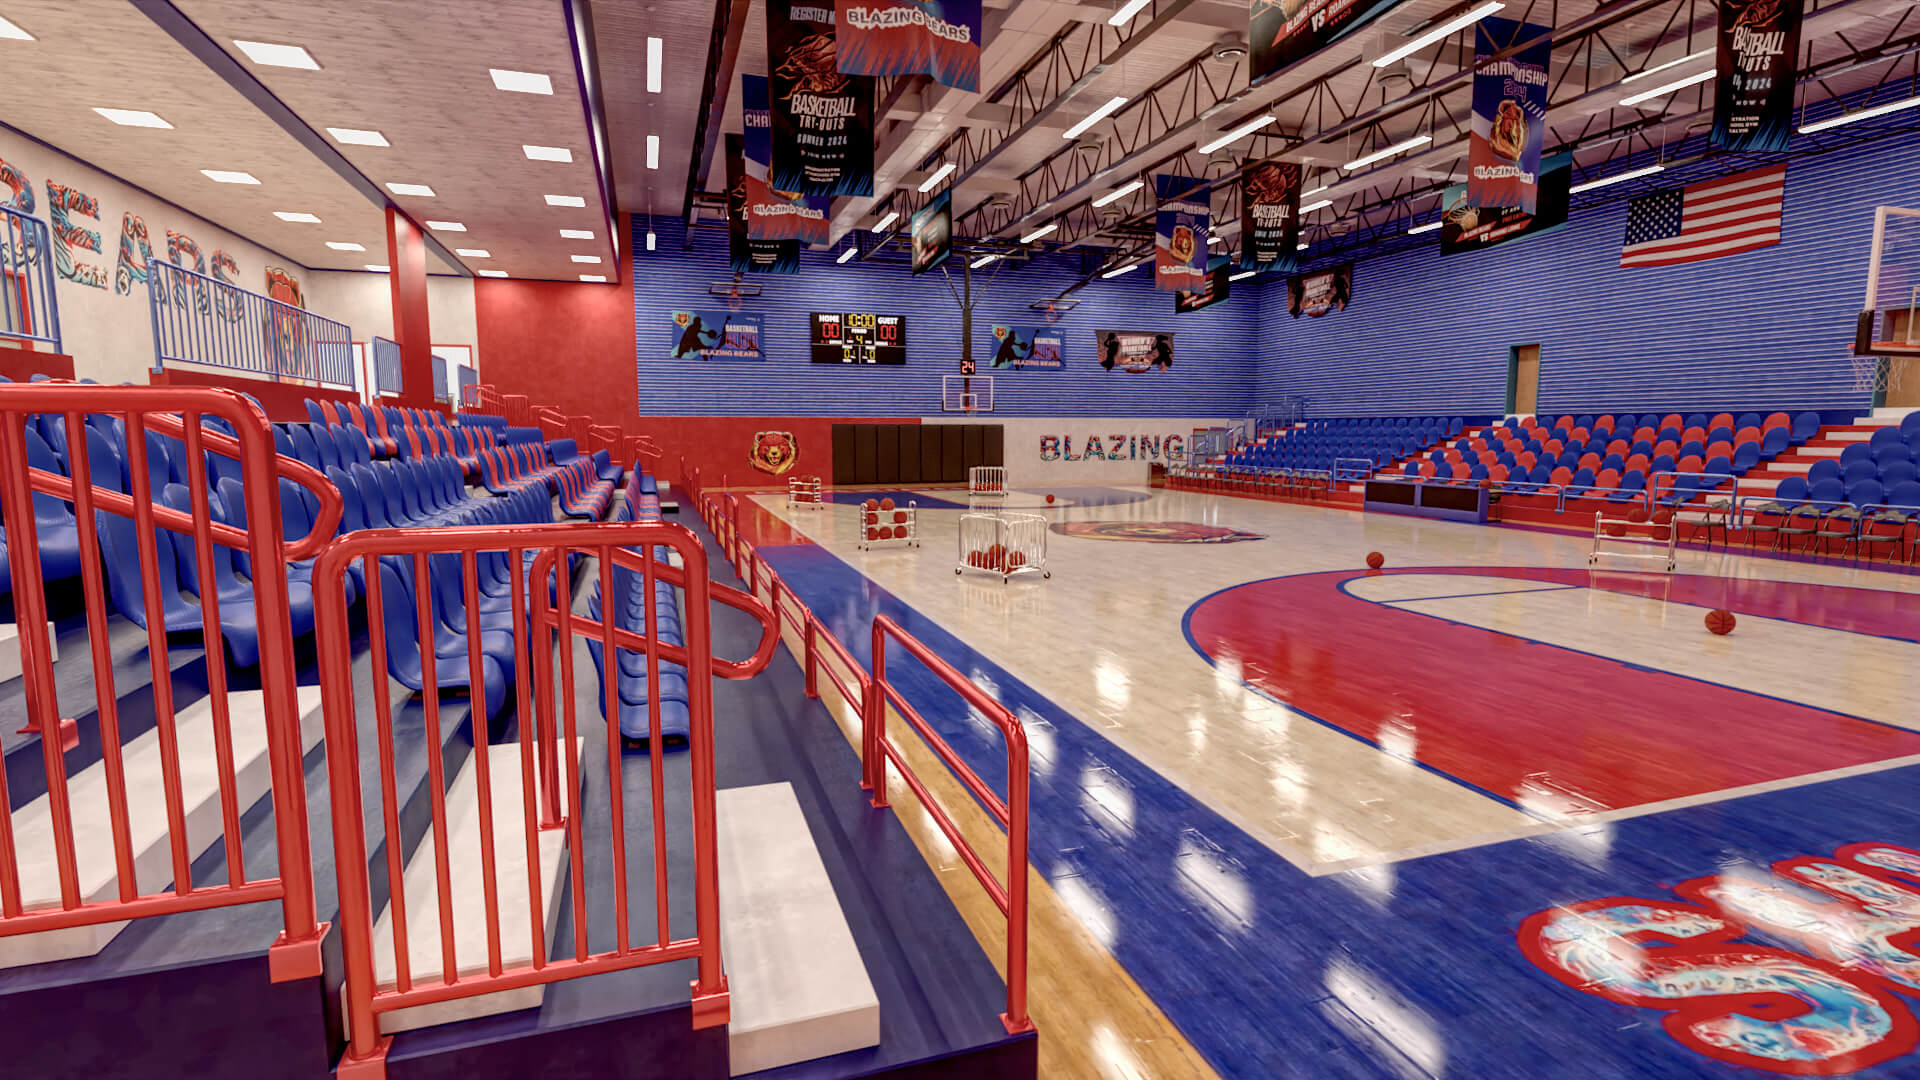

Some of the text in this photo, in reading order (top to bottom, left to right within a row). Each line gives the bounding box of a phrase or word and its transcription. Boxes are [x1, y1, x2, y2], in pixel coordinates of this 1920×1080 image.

[790, 6, 827, 23] REGISTER
[1311, 8, 1326, 33] VS
[847, 8, 923, 27] BLAZING
[925, 13, 970, 42] BEARS
[790, 94, 856, 117] BASKETBALL
[800, 115, 845, 131] TRY-OUTS
[1474, 166, 1519, 178] BLAZING
[753, 204, 796, 216] BLAZING
[819, 314, 840, 323] HOME
[848, 313, 875, 328] 10:00
[877, 317, 899, 325] GUEST
[822, 322, 839, 338] 00
[880, 324, 897, 340] 00
[961, 360, 975, 373] 24
[1039, 434, 1184, 462] BLAZING
